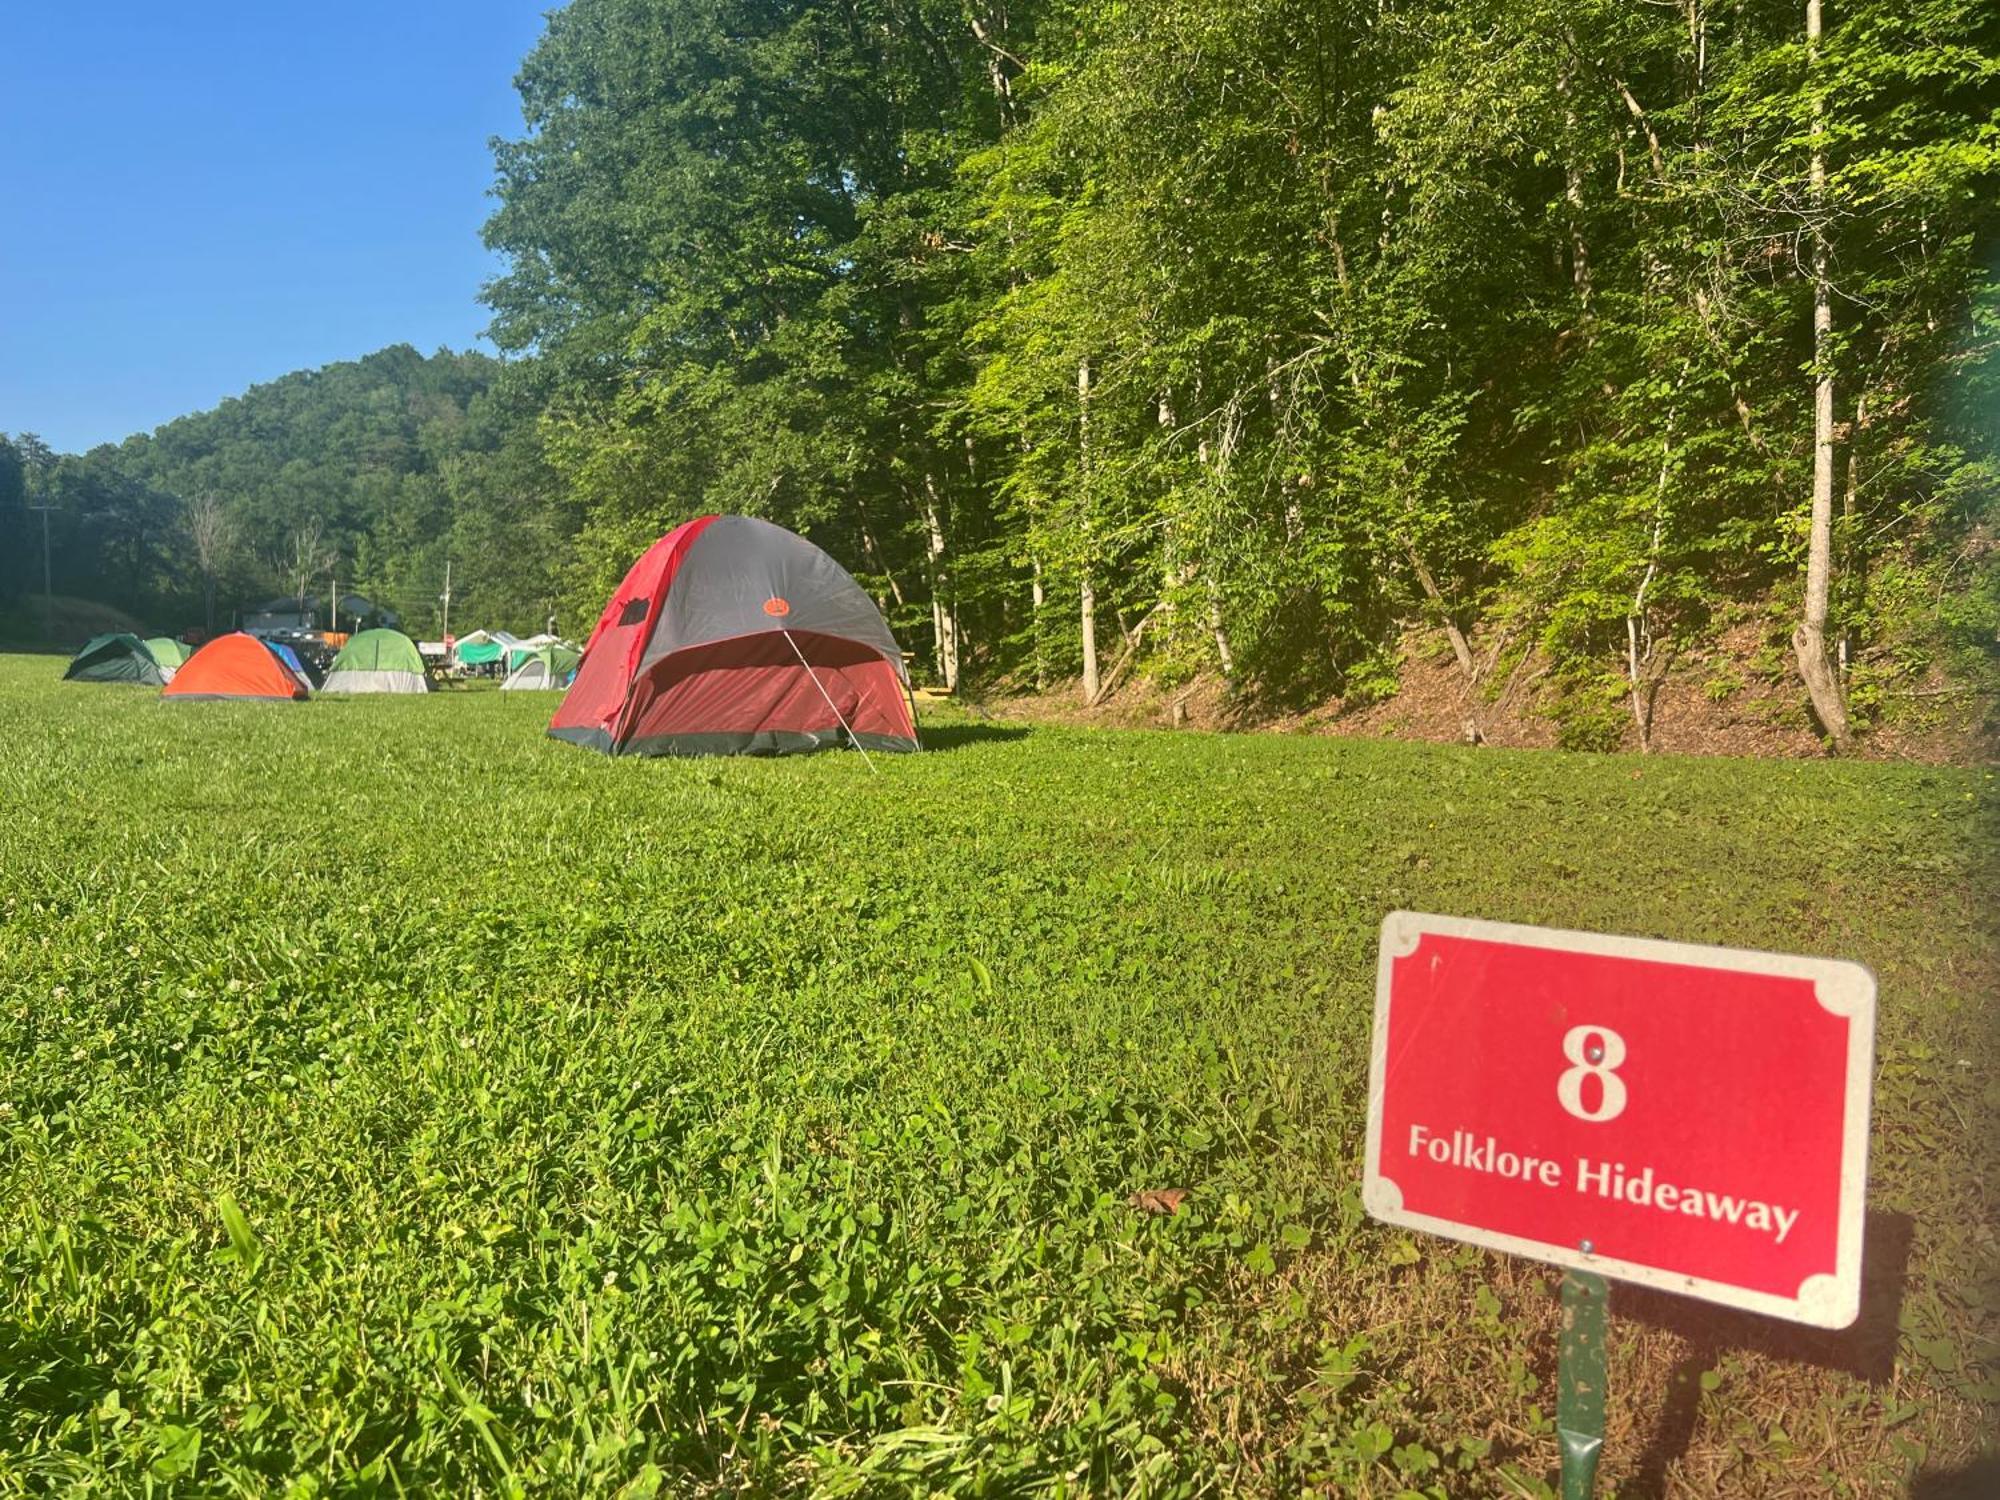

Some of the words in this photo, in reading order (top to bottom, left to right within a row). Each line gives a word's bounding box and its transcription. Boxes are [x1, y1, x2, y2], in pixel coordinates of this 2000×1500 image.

[1556, 1024, 1628, 1123] 8
[1408, 1124, 1562, 1187] Folklore
[1576, 1158, 1800, 1244] Hideaway
